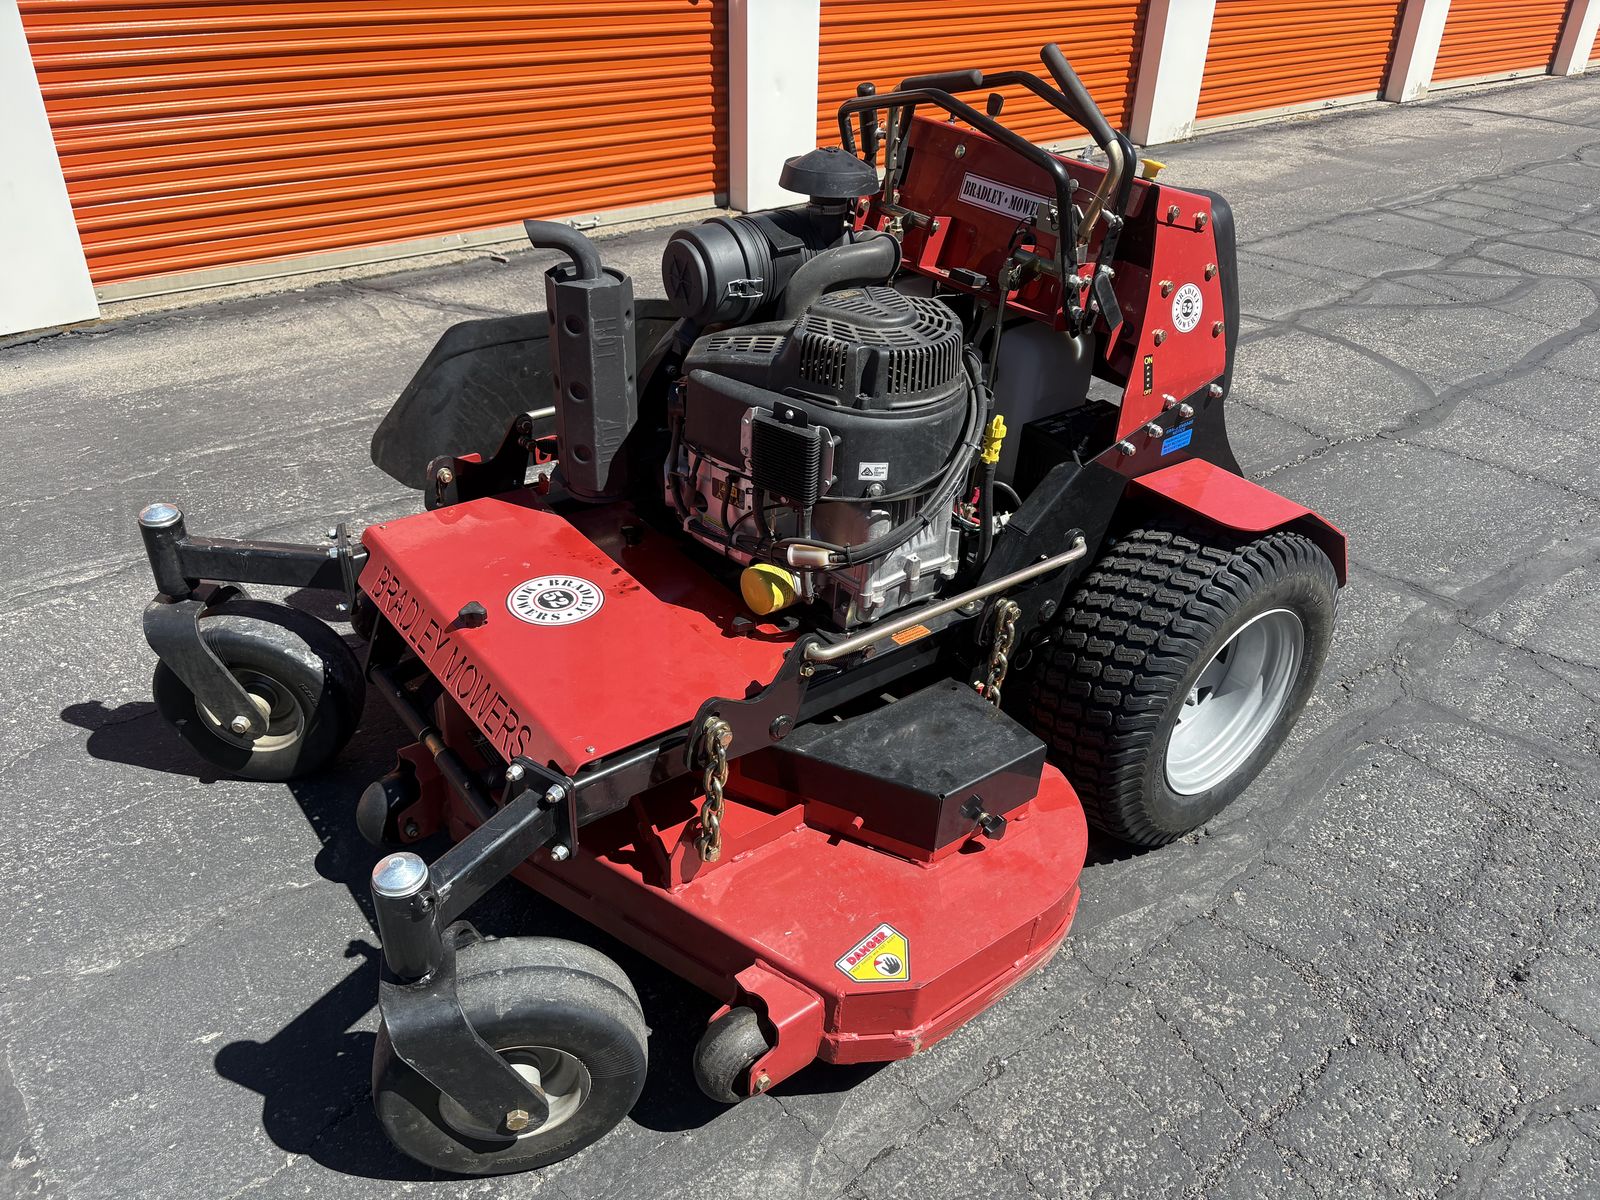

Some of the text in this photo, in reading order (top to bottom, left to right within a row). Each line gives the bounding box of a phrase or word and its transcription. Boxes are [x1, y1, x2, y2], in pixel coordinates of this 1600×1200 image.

[963, 181, 1004, 206] BRADLEY
[1182, 302, 1193, 313] 52
[1144, 357, 1153, 365] ON
[516, 586, 560, 621] MOWERS
[542, 591, 570, 608] 52
[549, 579, 595, 614] BRADLEY
[370, 565, 532, 760] BRADLEY MOWERS
[846, 931, 888, 966] DANGER
